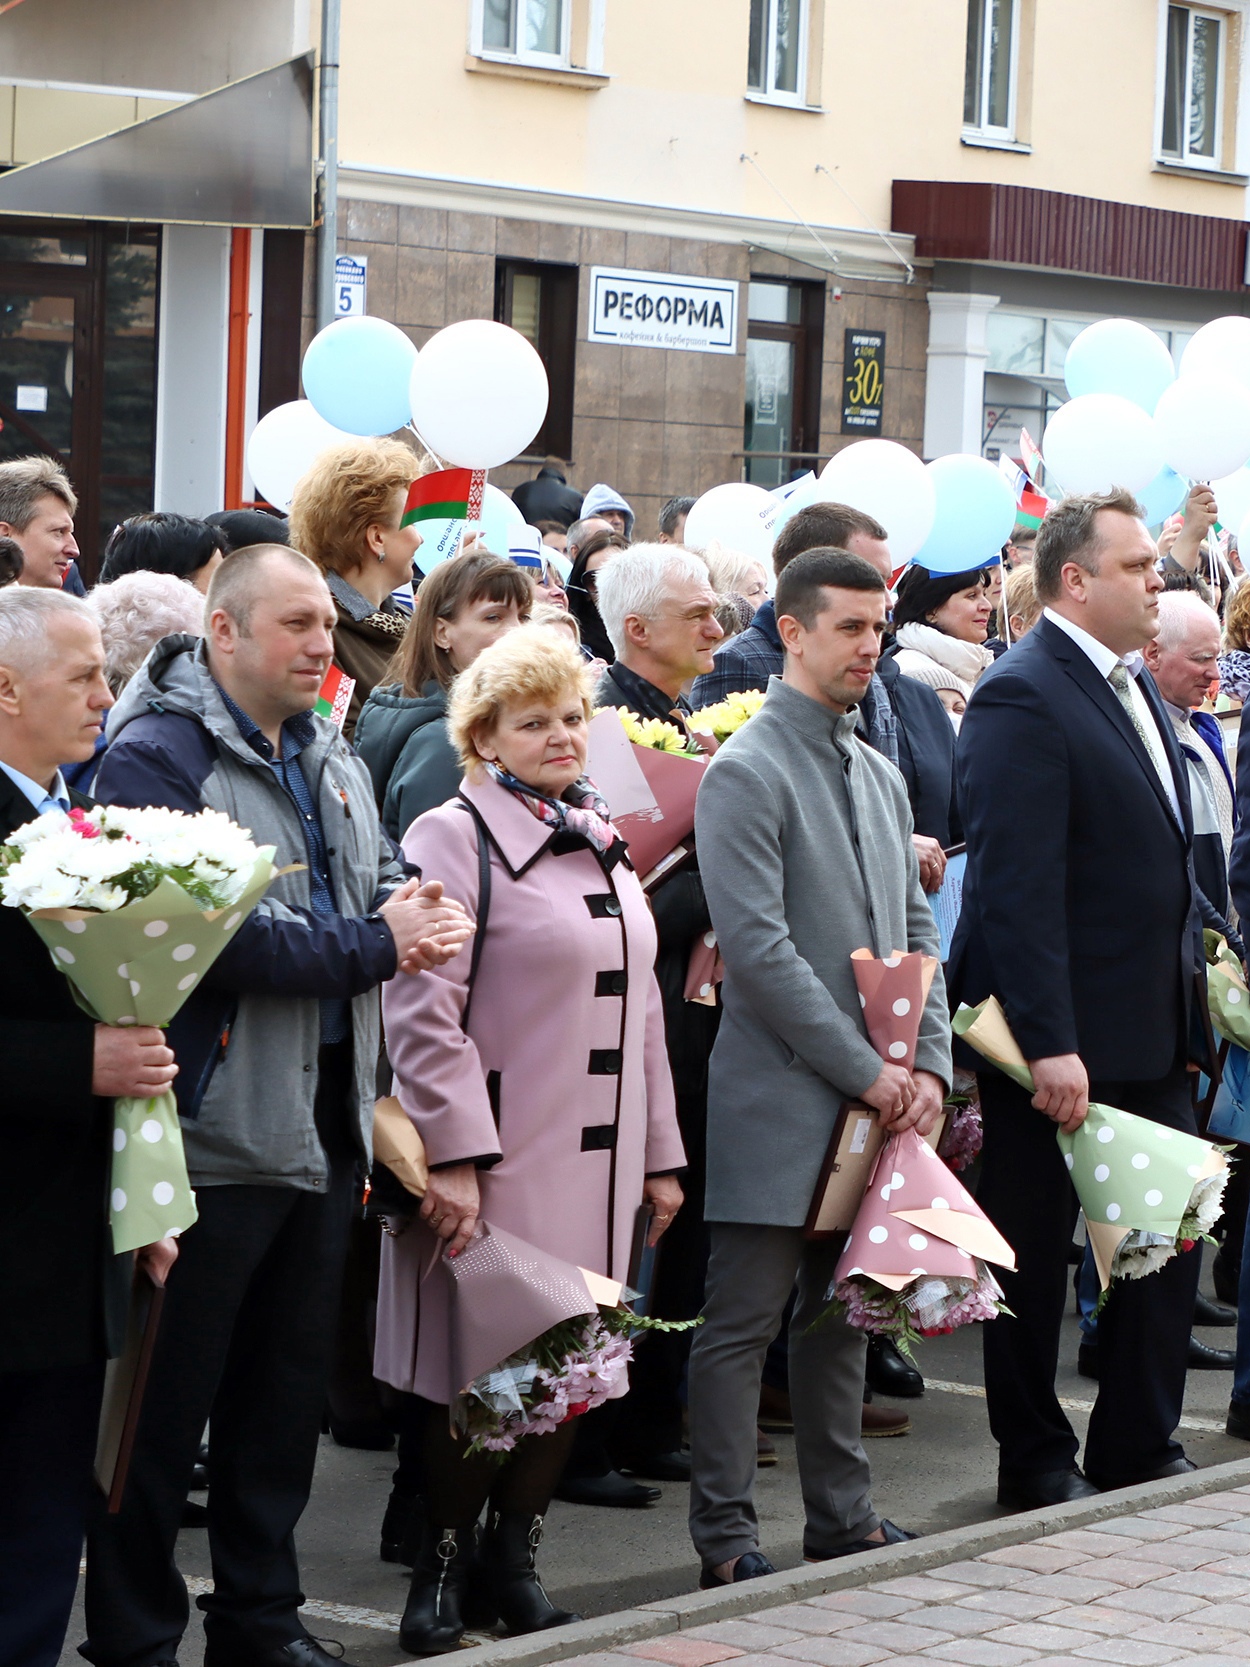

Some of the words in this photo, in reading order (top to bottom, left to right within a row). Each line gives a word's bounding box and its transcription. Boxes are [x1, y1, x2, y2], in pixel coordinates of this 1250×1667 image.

[339, 286, 352, 312] 5
[604, 289, 725, 329] РЕФОРМА
[437, 518, 458, 552] Оршанс
